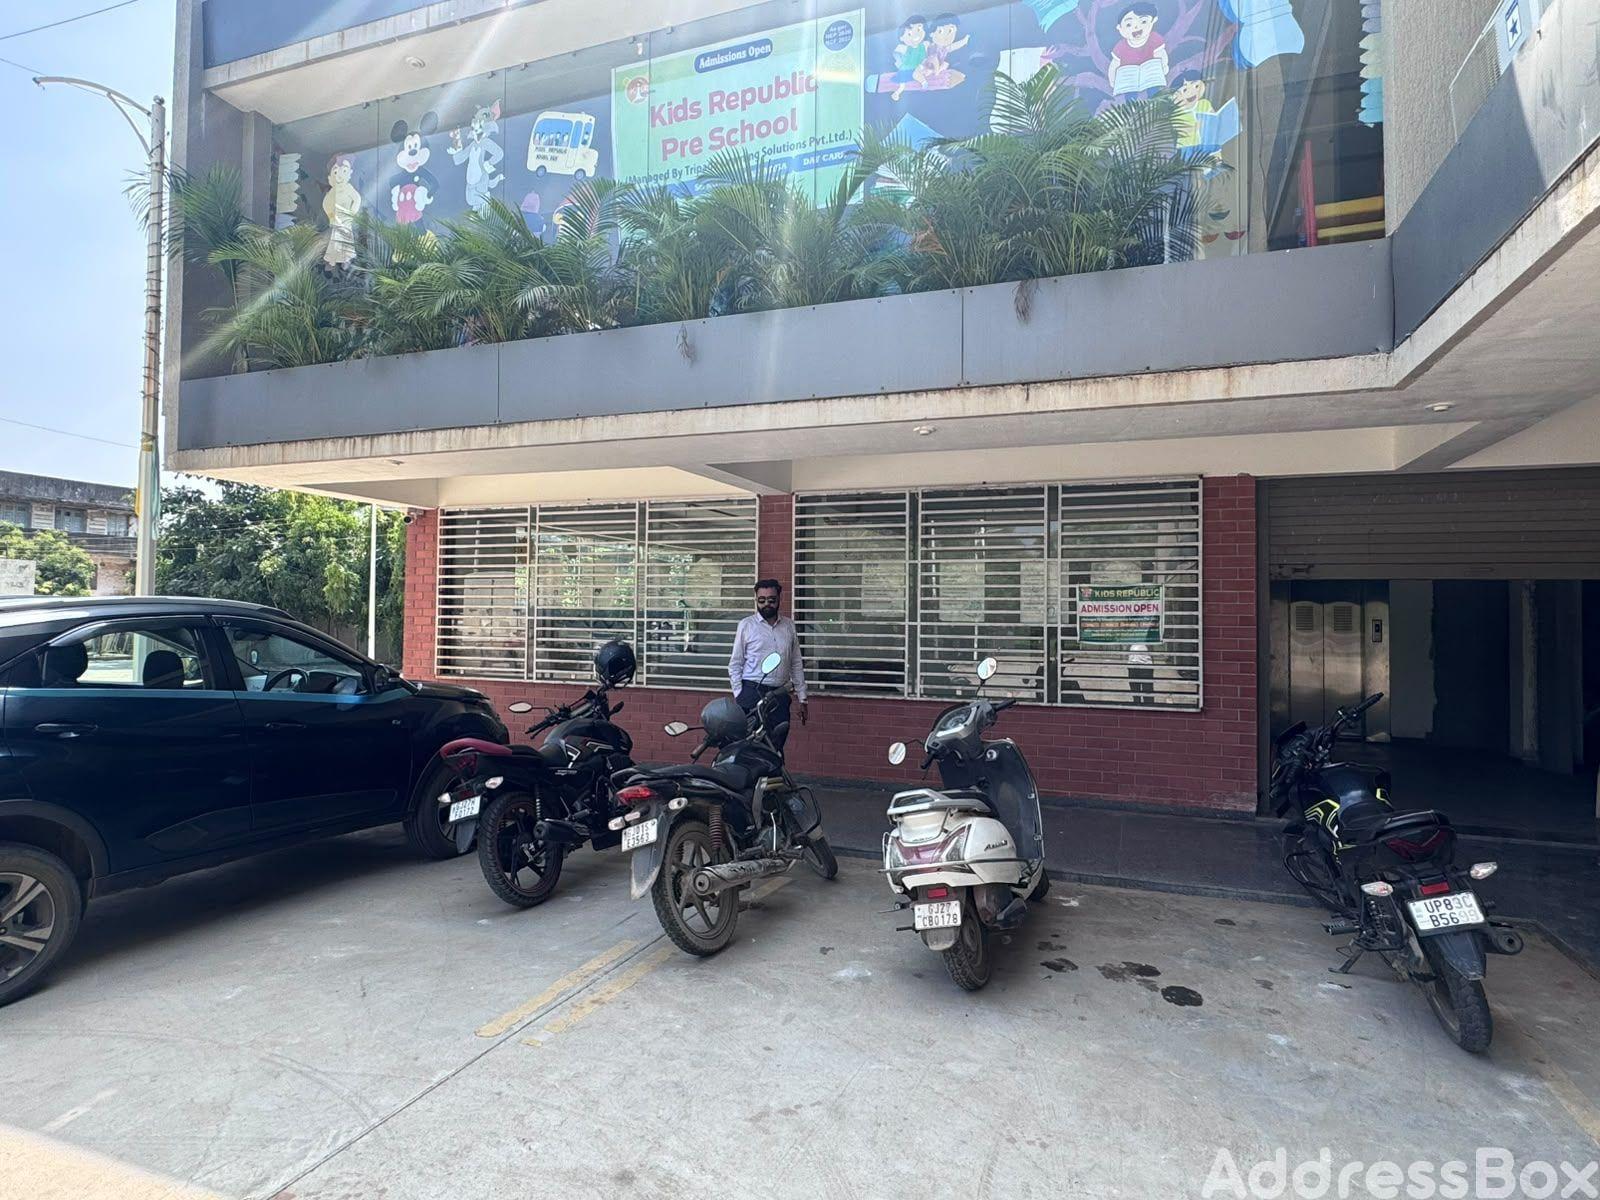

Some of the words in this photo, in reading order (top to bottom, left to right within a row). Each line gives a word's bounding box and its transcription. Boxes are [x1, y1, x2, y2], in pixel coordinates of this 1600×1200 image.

[699, 50, 747, 69] Admissions
[748, 44, 771, 59] Open
[650, 97, 702, 128] Kids
[708, 70, 818, 115] Republic
[661, 136, 703, 161] Pre
[708, 107, 798, 151] School
[672, 168, 683, 179] By
[761, 139, 807, 156] Solutions
[1094, 589, 1115, 598] KIDS
[1116, 588, 1159, 597] REPUBLIC
[1081, 604, 1132, 613] ADMISSION
[1133, 603, 1159, 613] OPEN
[927, 902, 951, 914] GJ27
[1424, 895, 1473, 914] UP83C
[922, 913, 958, 927] CB0178
